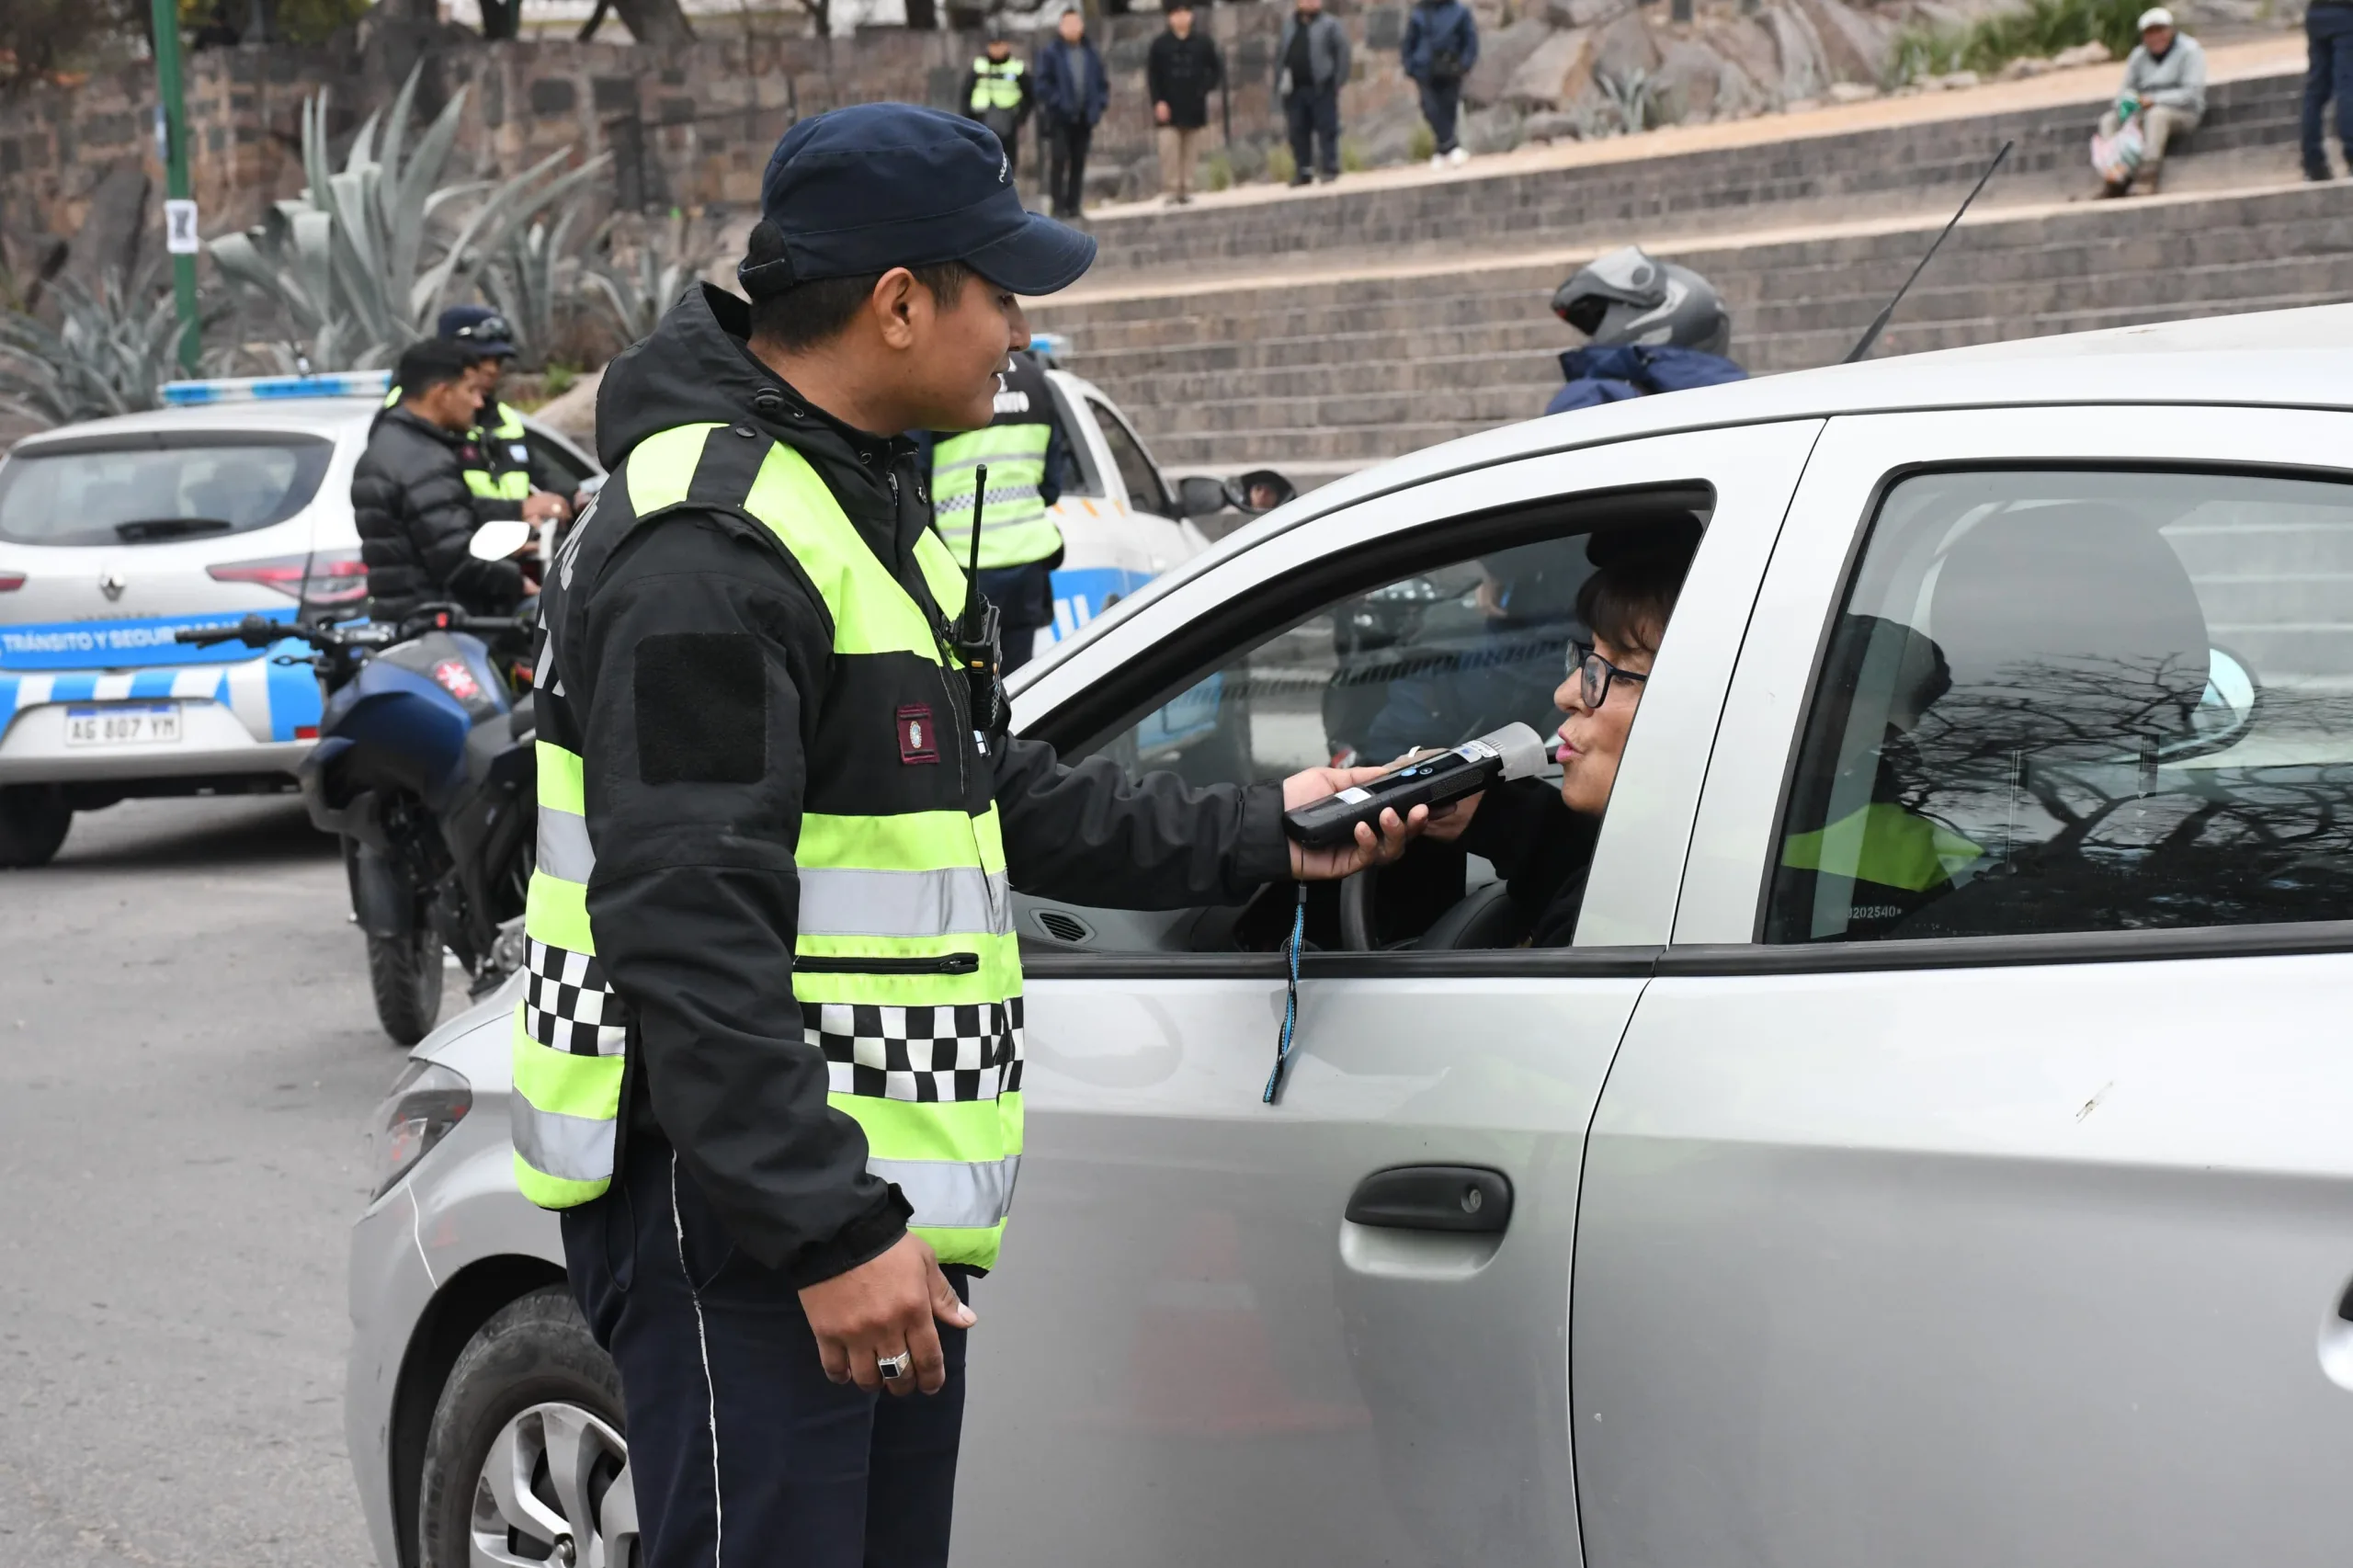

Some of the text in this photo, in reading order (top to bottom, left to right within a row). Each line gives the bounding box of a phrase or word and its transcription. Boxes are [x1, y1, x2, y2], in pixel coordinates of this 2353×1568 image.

[94, 630, 108, 651] Y
[72, 719, 97, 740] AG
[105, 718, 142, 739] 807
